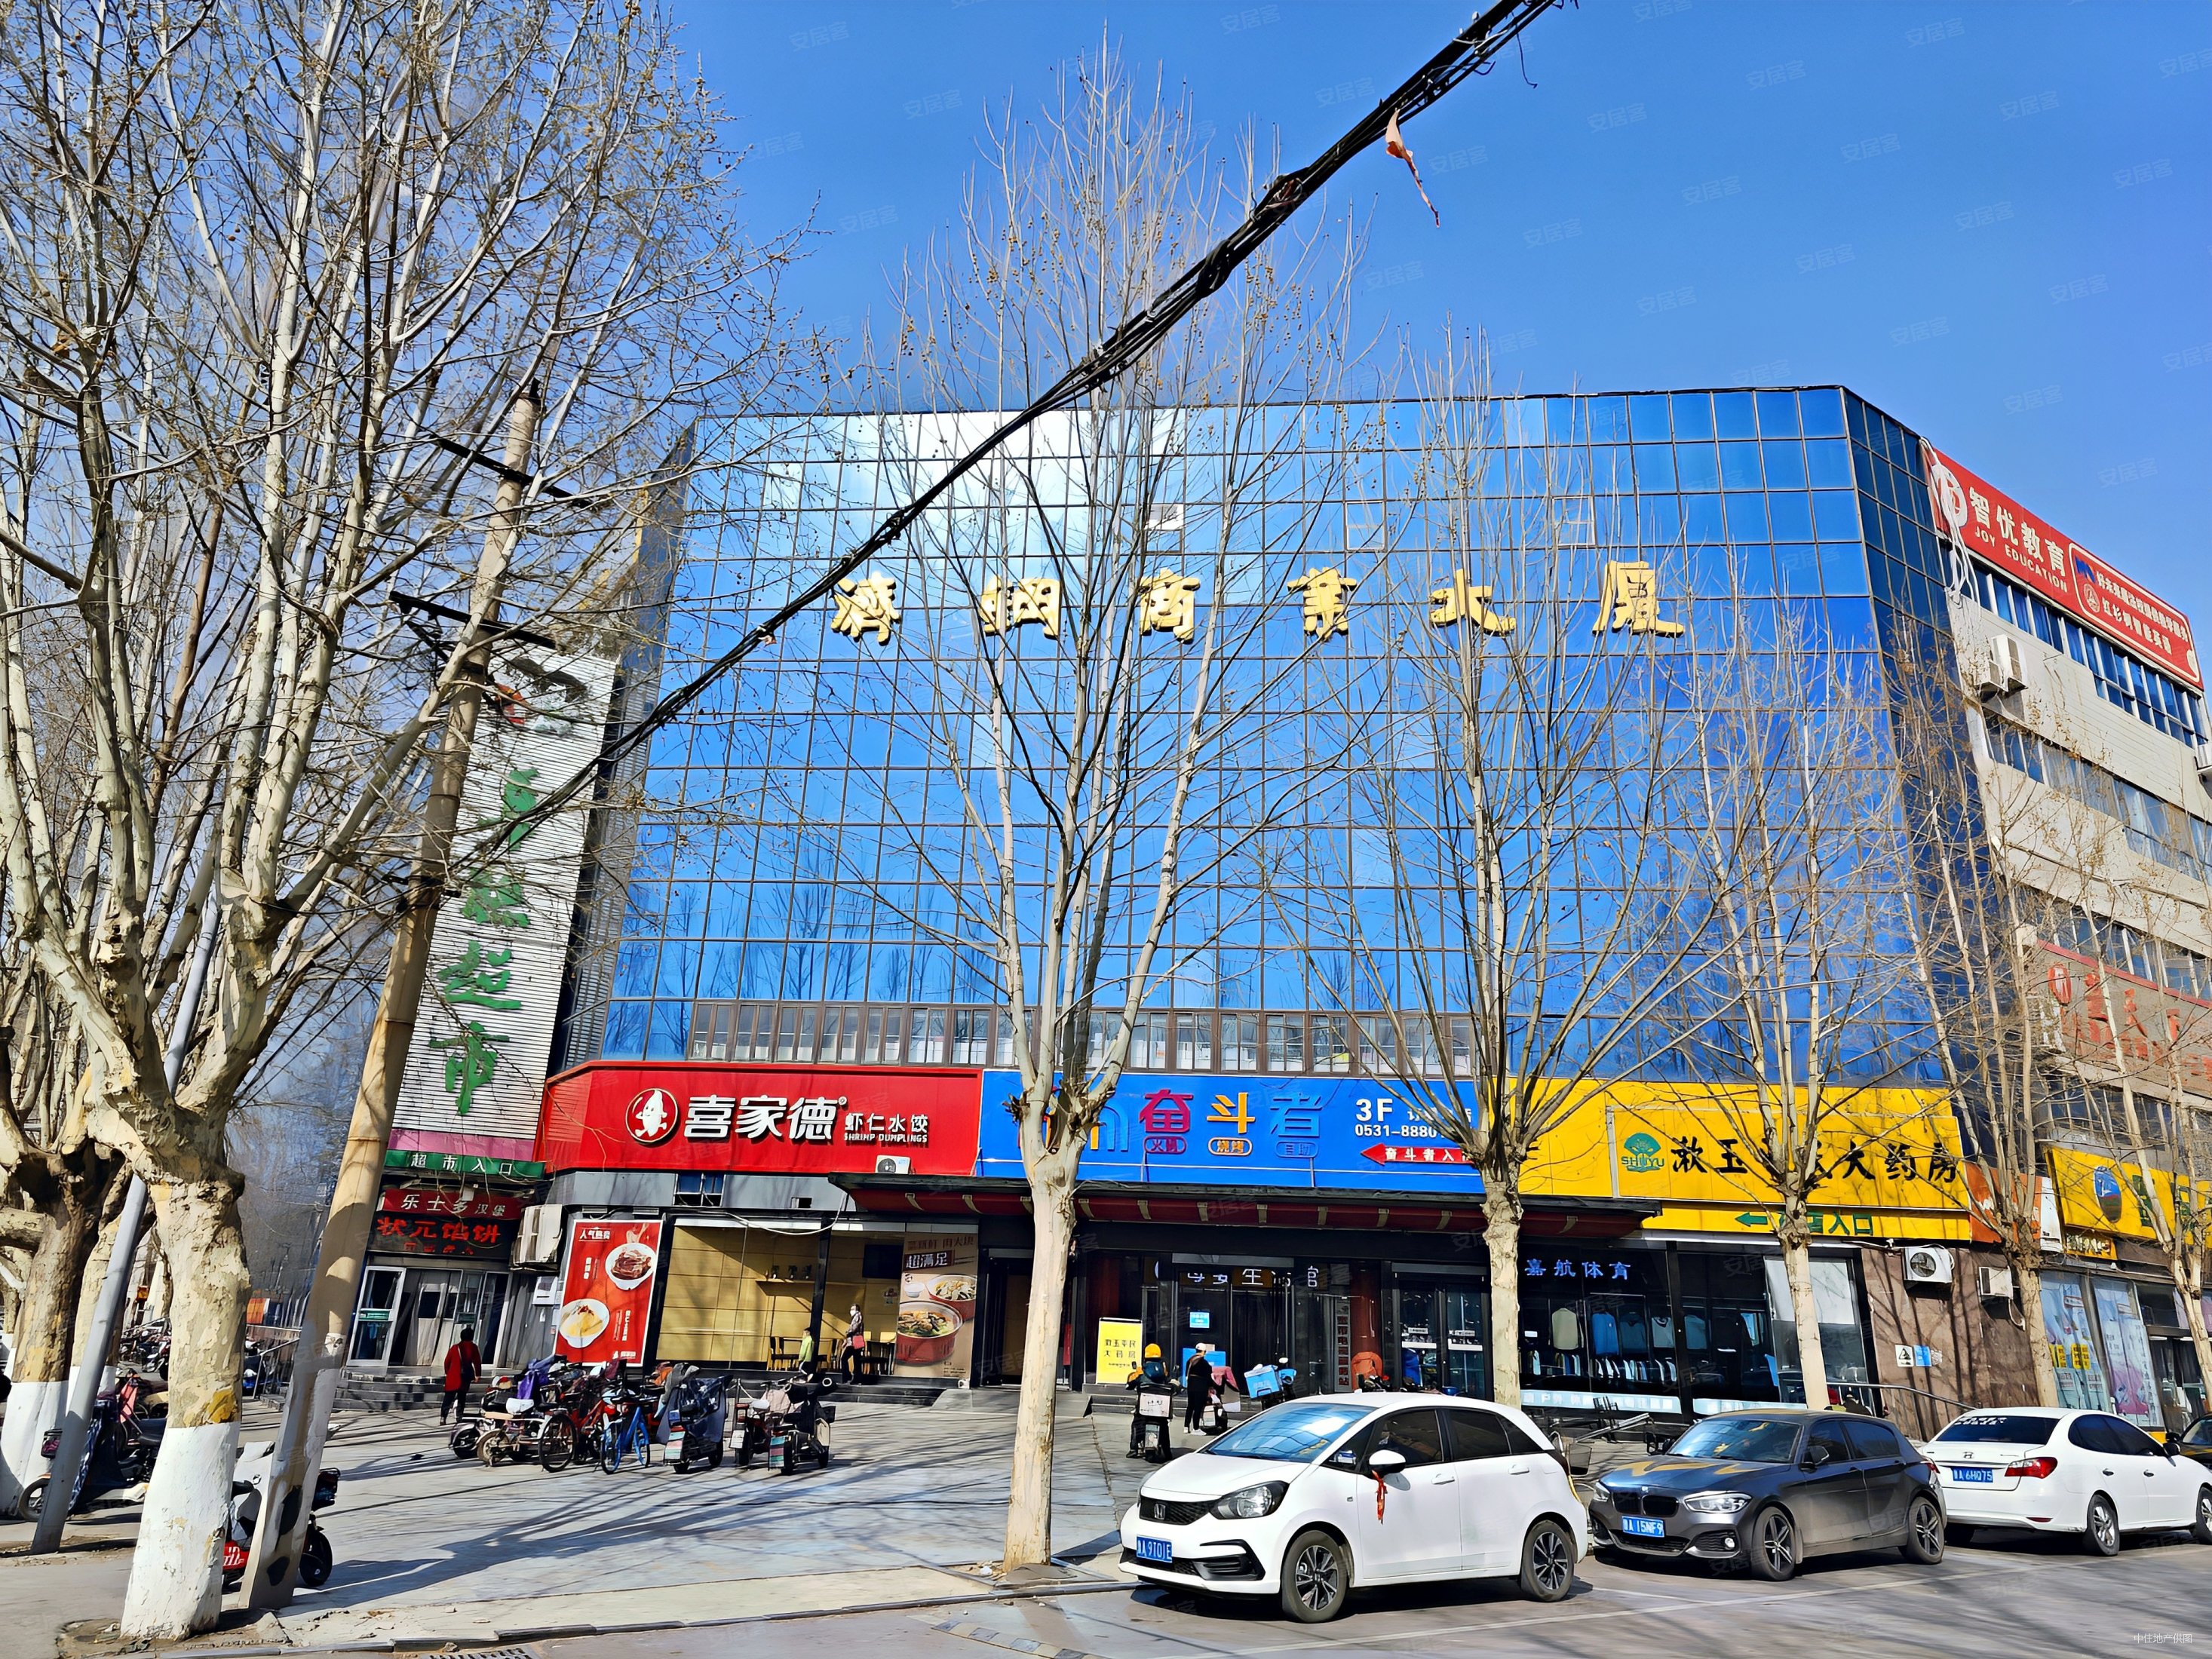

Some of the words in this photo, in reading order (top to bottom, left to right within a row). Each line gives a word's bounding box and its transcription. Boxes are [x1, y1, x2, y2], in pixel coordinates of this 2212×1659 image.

[1969, 486, 2066, 577] 智优教育
[1975, 526, 1996, 547] JOY
[2005, 544, 2068, 593] EDUCATION
[676, 1094, 839, 1139] 喜家德
[845, 1112, 928, 1133] 虾仁水饺
[1139, 1089, 1323, 1138] 奋斗者
[1355, 1098, 1393, 1122] 3F
[844, 1133, 875, 1142] SHRIMP
[879, 1133, 928, 1142] DUMPLINGS
[410, 1152, 514, 1176] 超市入口
[376, 1216, 502, 1243] 状元馅饼
[1524, 1259, 1631, 1280] 嘉航体育
